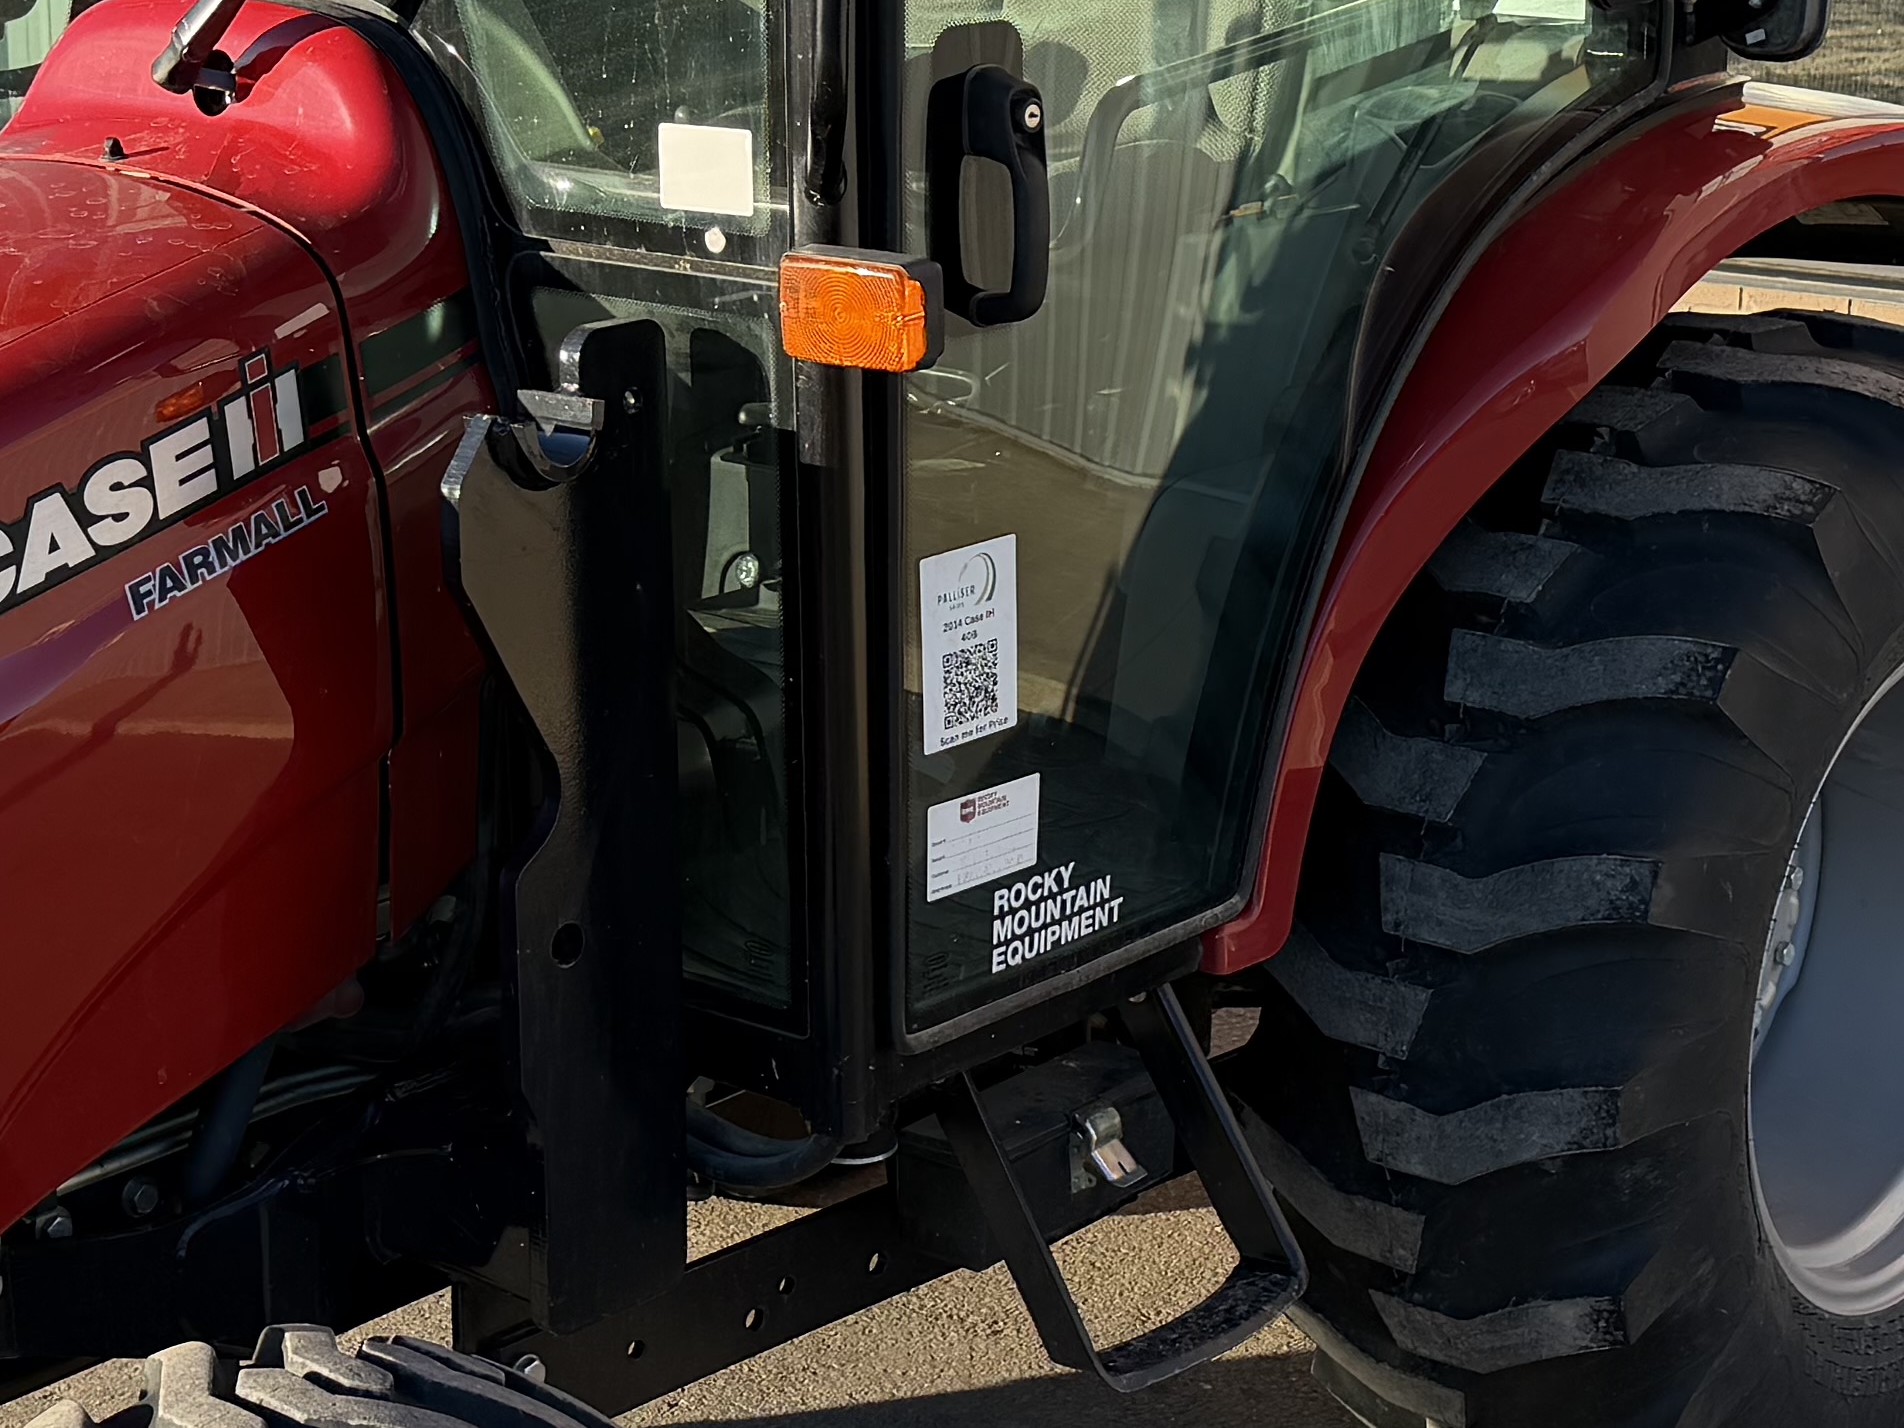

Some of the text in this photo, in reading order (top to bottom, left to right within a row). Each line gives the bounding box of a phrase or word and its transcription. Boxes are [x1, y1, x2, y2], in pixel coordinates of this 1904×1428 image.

[124, 486, 327, 621] FARMALL
[937, 585, 976, 606] PALLISER
[942, 619, 963, 633] 2014
[964, 613, 984, 626] Case
[992, 875, 1111, 946] MOUNTAIN
[993, 861, 1076, 916] ROCKY
[992, 897, 1124, 974] EQUIPMENT
